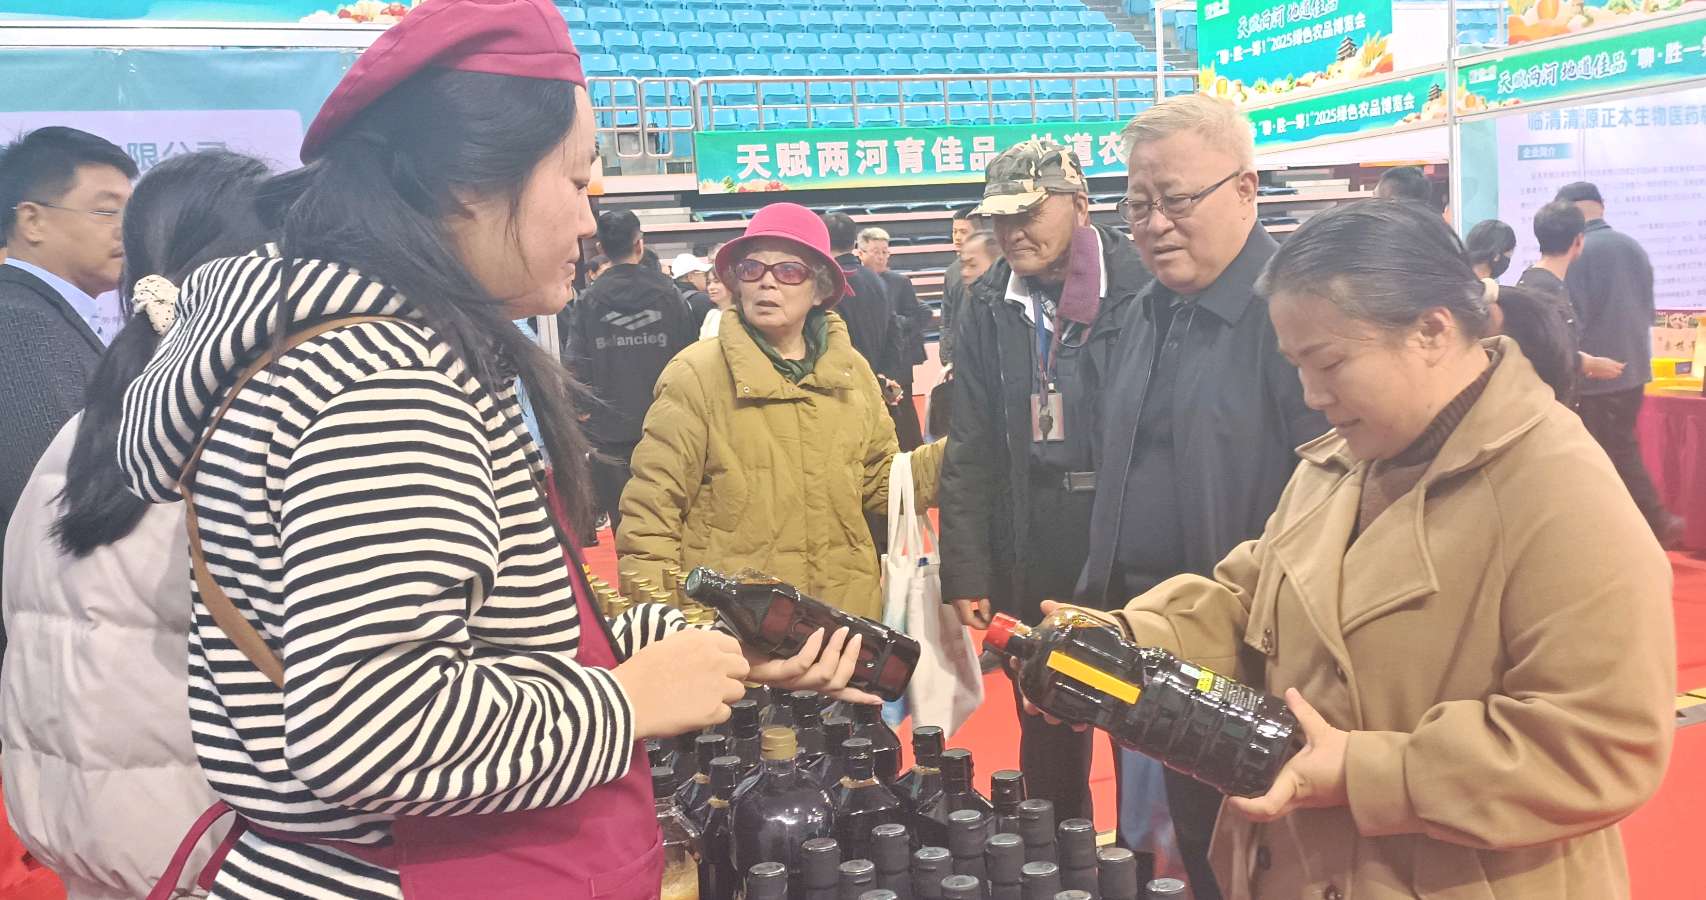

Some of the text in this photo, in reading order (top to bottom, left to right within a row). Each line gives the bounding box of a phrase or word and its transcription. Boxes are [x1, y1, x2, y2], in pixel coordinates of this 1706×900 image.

[1497, 61, 1558, 94] 天赋两河
[1561, 50, 1628, 80] 地道佳品
[736, 132, 1128, 179] 天赋两河育佳品 道农
